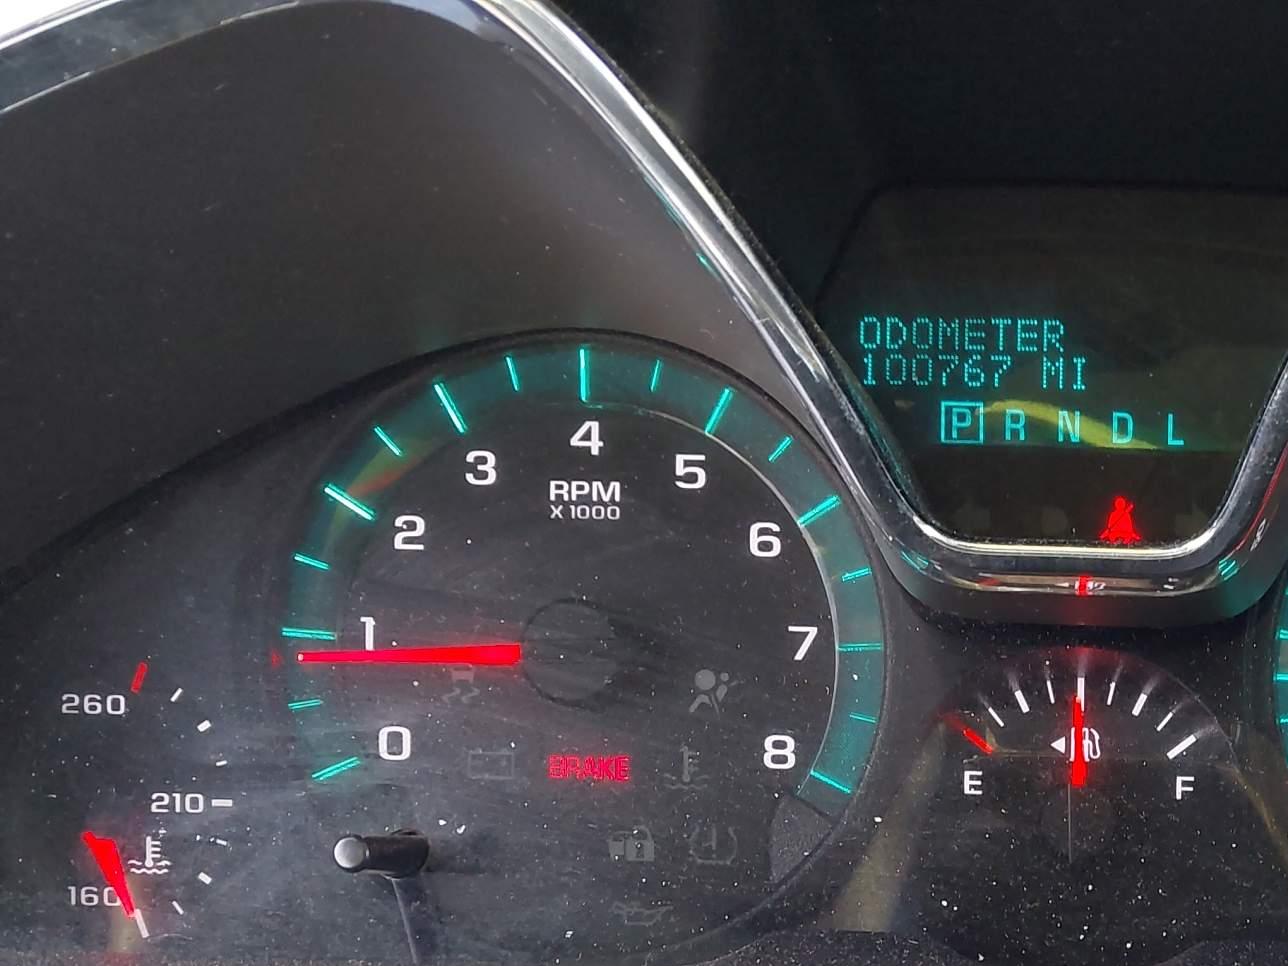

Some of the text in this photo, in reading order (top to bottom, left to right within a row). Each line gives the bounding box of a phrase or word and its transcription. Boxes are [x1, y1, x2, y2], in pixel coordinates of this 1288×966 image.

[859, 316, 1065, 353] ODOMETER
[863, 353, 1086, 391] 100767 MI
[569, 420, 604, 456] 4
[951, 407, 1185, 446] P R N D L
[465, 450, 497, 486] 3
[675, 453, 706, 489] 5
[549, 480, 621, 502] RPM
[550, 504, 620, 520] X 1000
[394, 515, 425, 550] 2
[749, 522, 782, 558] 6
[360, 616, 376, 651] 1
[788, 625, 818, 661] 7
[62, 693, 126, 715] 260
[378, 725, 411, 761] 0
[763, 734, 796, 770] 8
[547, 753, 631, 782] BRAKE
[963, 770, 983, 795] E
[151, 792, 204, 813] 210
[1175, 775, 1195, 800] F
[66, 885, 121, 907] 160
